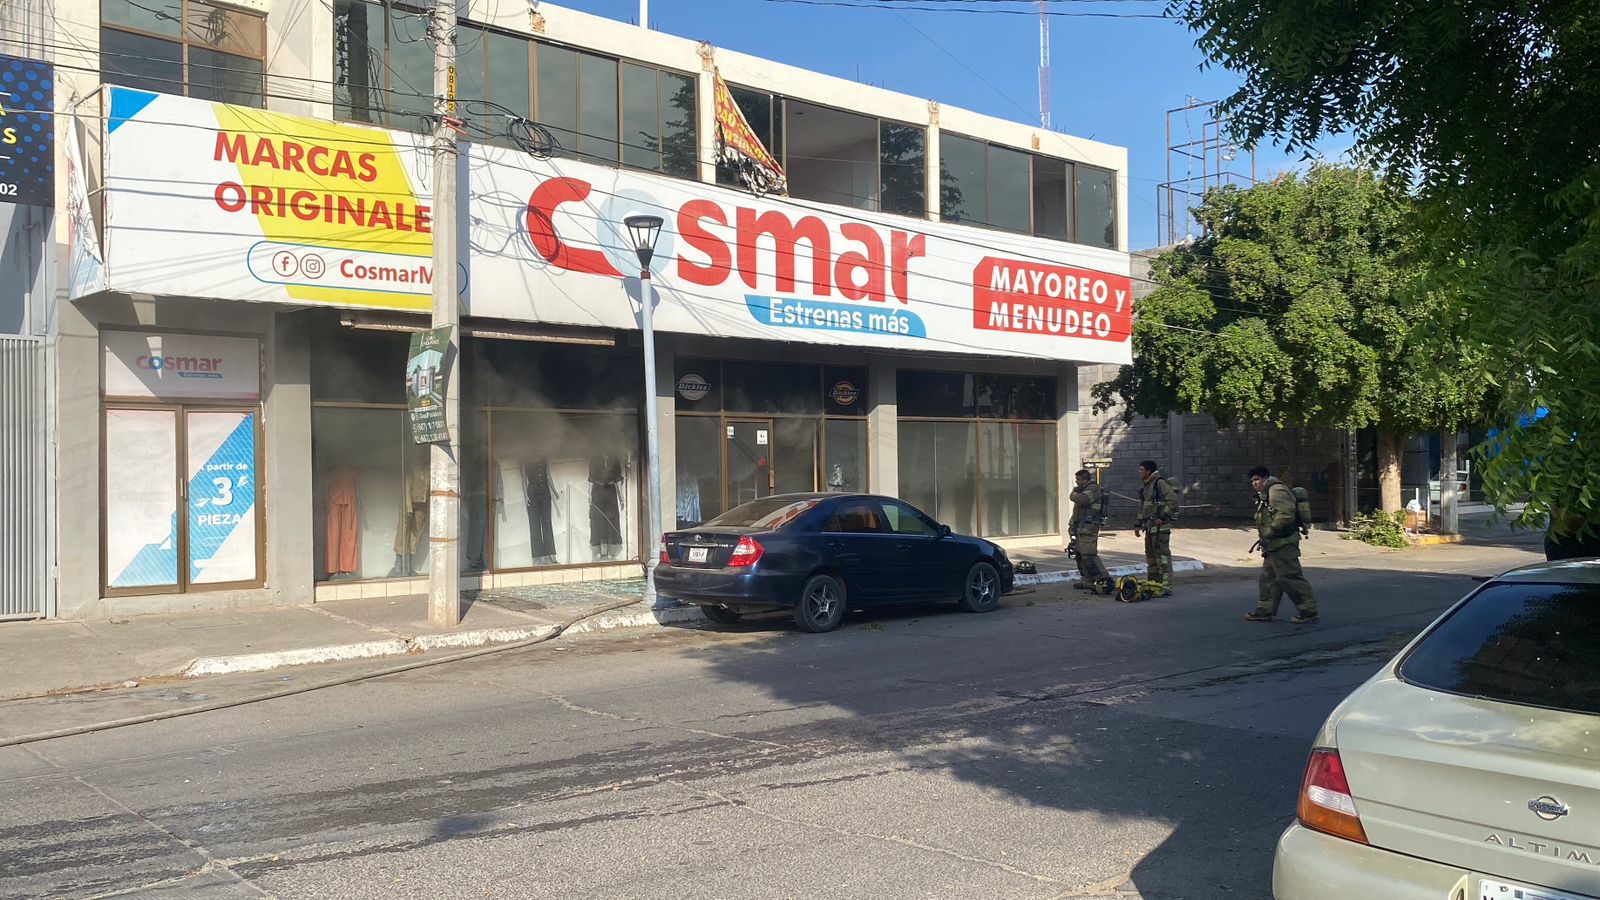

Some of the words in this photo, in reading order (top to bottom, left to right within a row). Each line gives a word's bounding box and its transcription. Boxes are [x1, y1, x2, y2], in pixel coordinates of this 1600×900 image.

[213, 131, 378, 183] MARCAS
[214, 180, 432, 234] ORIGINALE
[339, 258, 433, 285] CosmarM
[989, 265, 1109, 304] MAYOREO
[769, 298, 863, 329] Estrenas
[868, 308, 910, 334] más
[988, 301, 1112, 338] MENUDEO
[135, 355, 223, 372] cosmar
[206, 462, 234, 472] partir
[235, 461, 249, 471] de
[211, 476, 234, 506] 3
[1483, 833, 1600, 866] ALTIM
